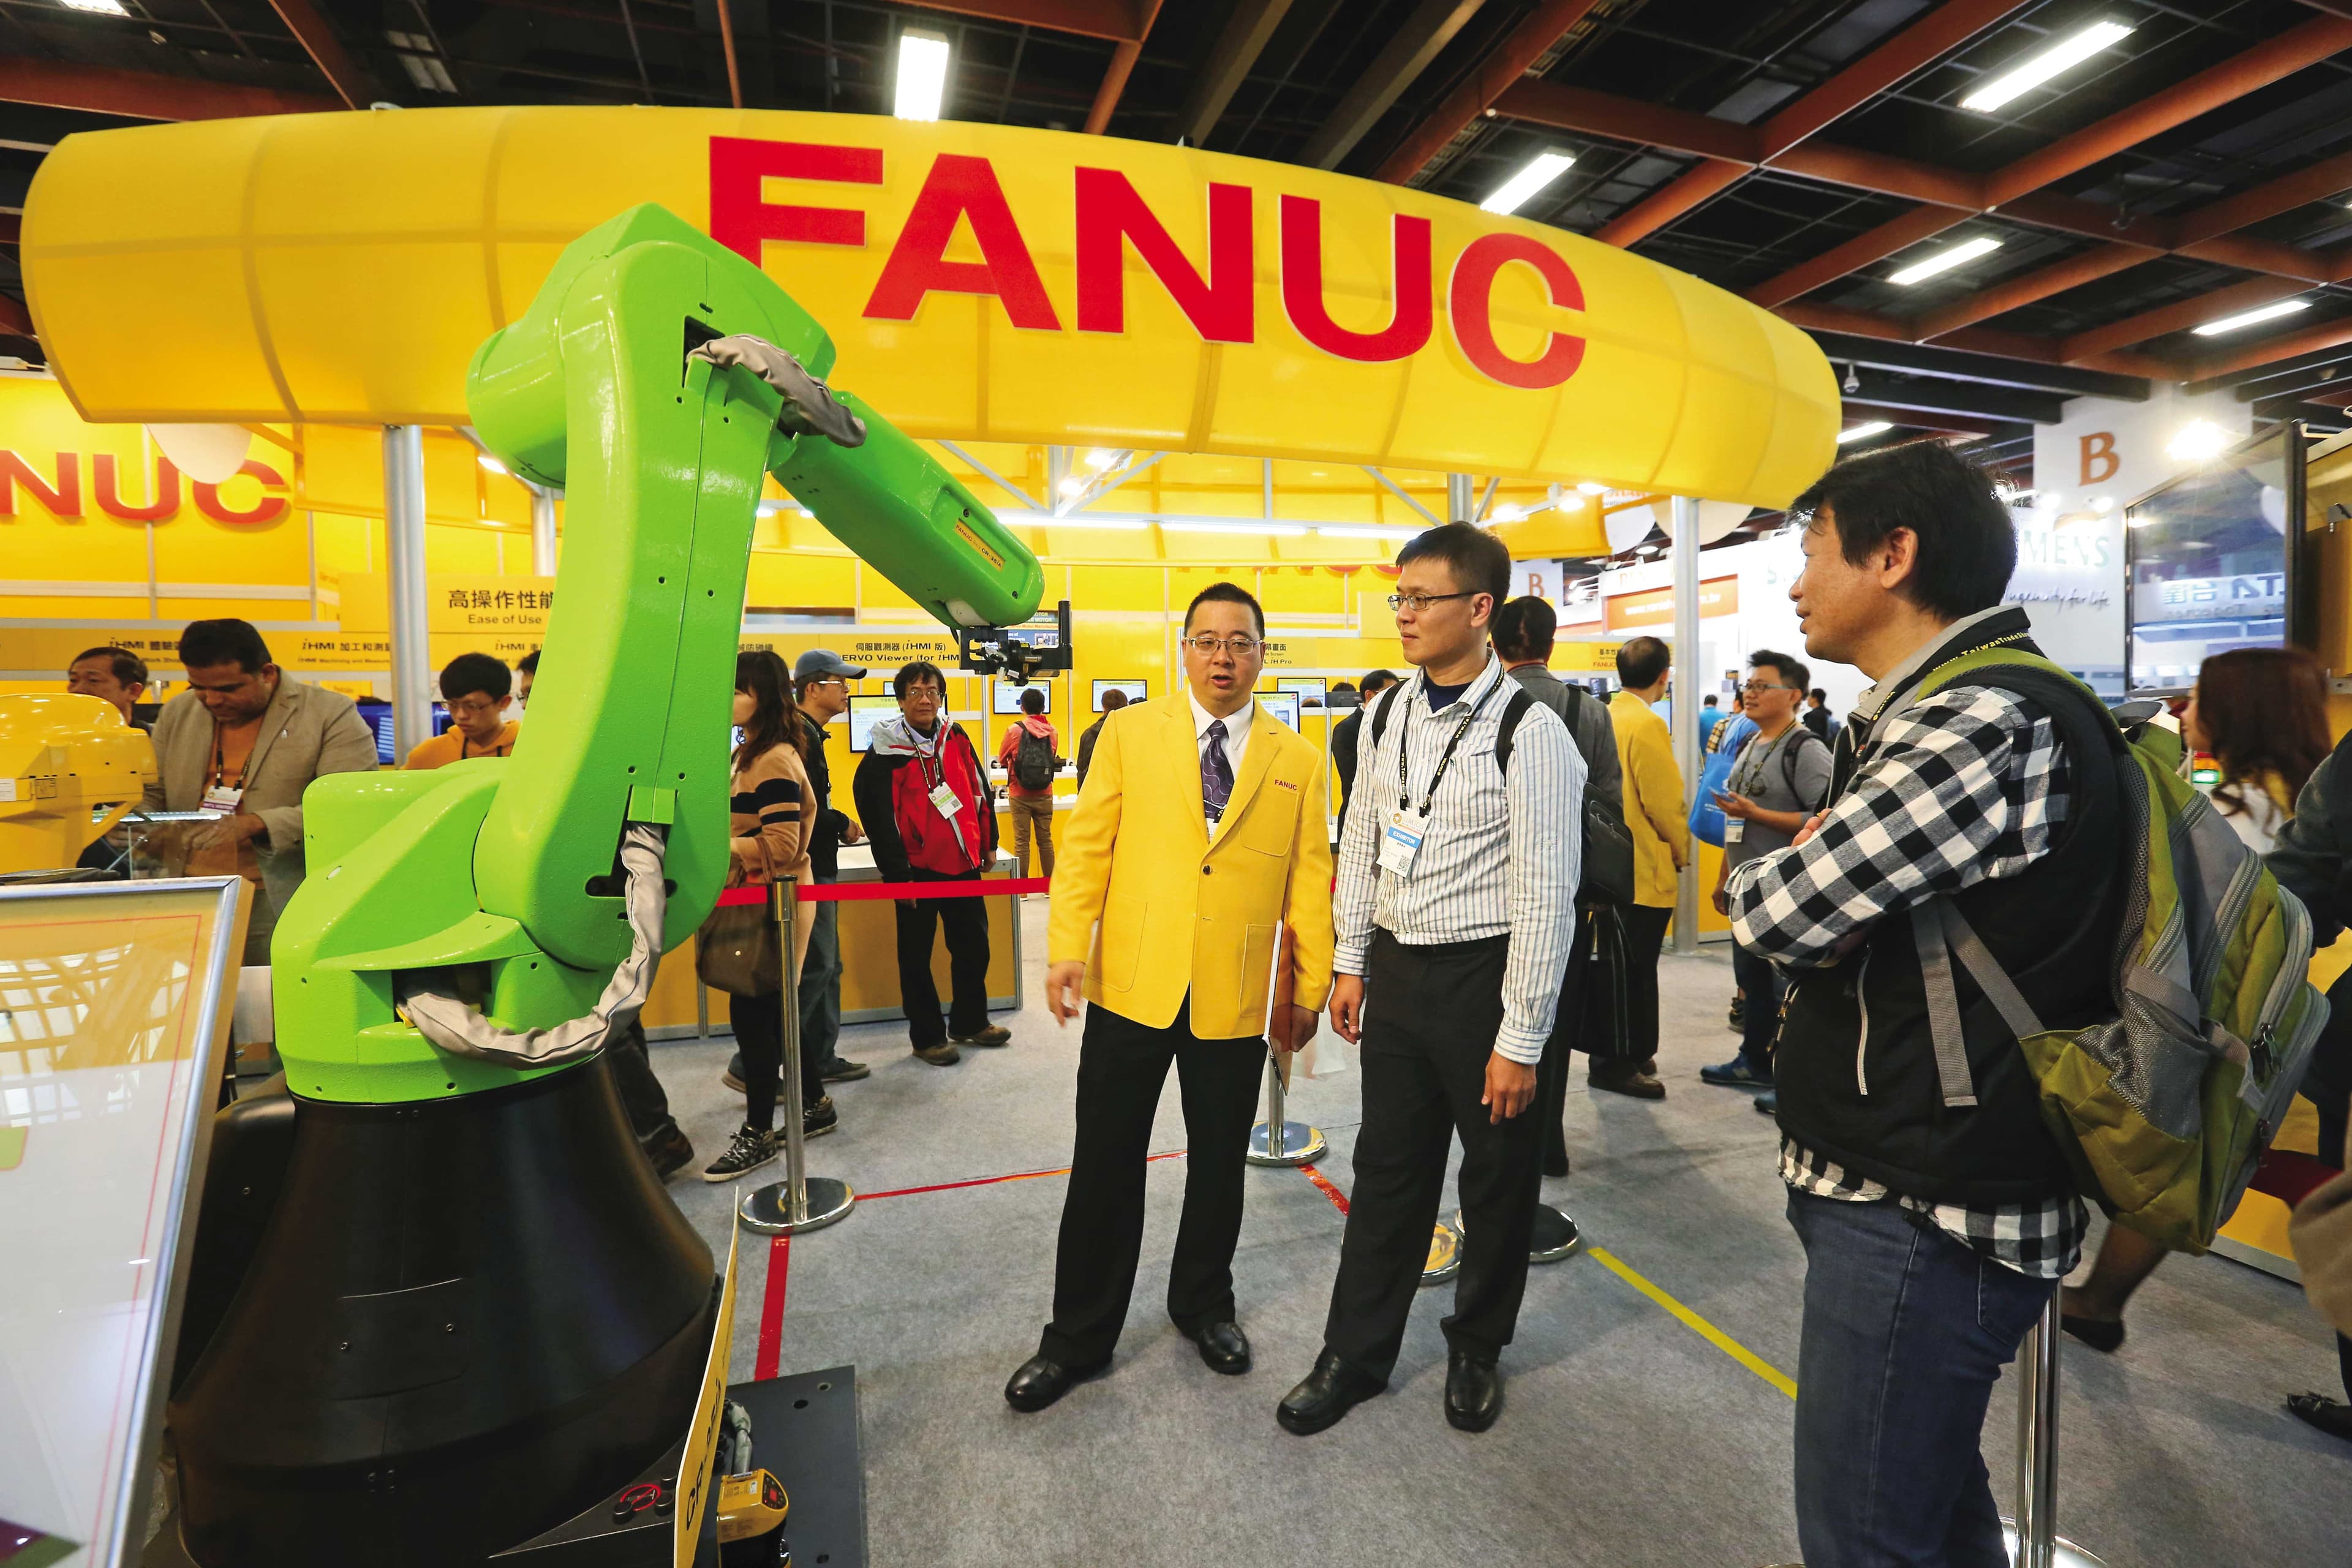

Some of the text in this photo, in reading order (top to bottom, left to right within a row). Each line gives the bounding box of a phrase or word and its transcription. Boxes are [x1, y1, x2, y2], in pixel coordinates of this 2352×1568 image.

[709, 135, 1586, 390] FANUC
[2079, 432, 2120, 486] B
[0, 450, 289, 525] NUC
[956, 524, 973, 541] FANUC
[2023, 530, 2109, 568] MENS
[1528, 573, 1545, 597] B
[468, 614, 542, 624] Ease of Use
[938, 651, 959, 662] iHM
[1275, 779, 1297, 791] FANUC
[1392, 831, 1416, 845] EXHIBITOR
